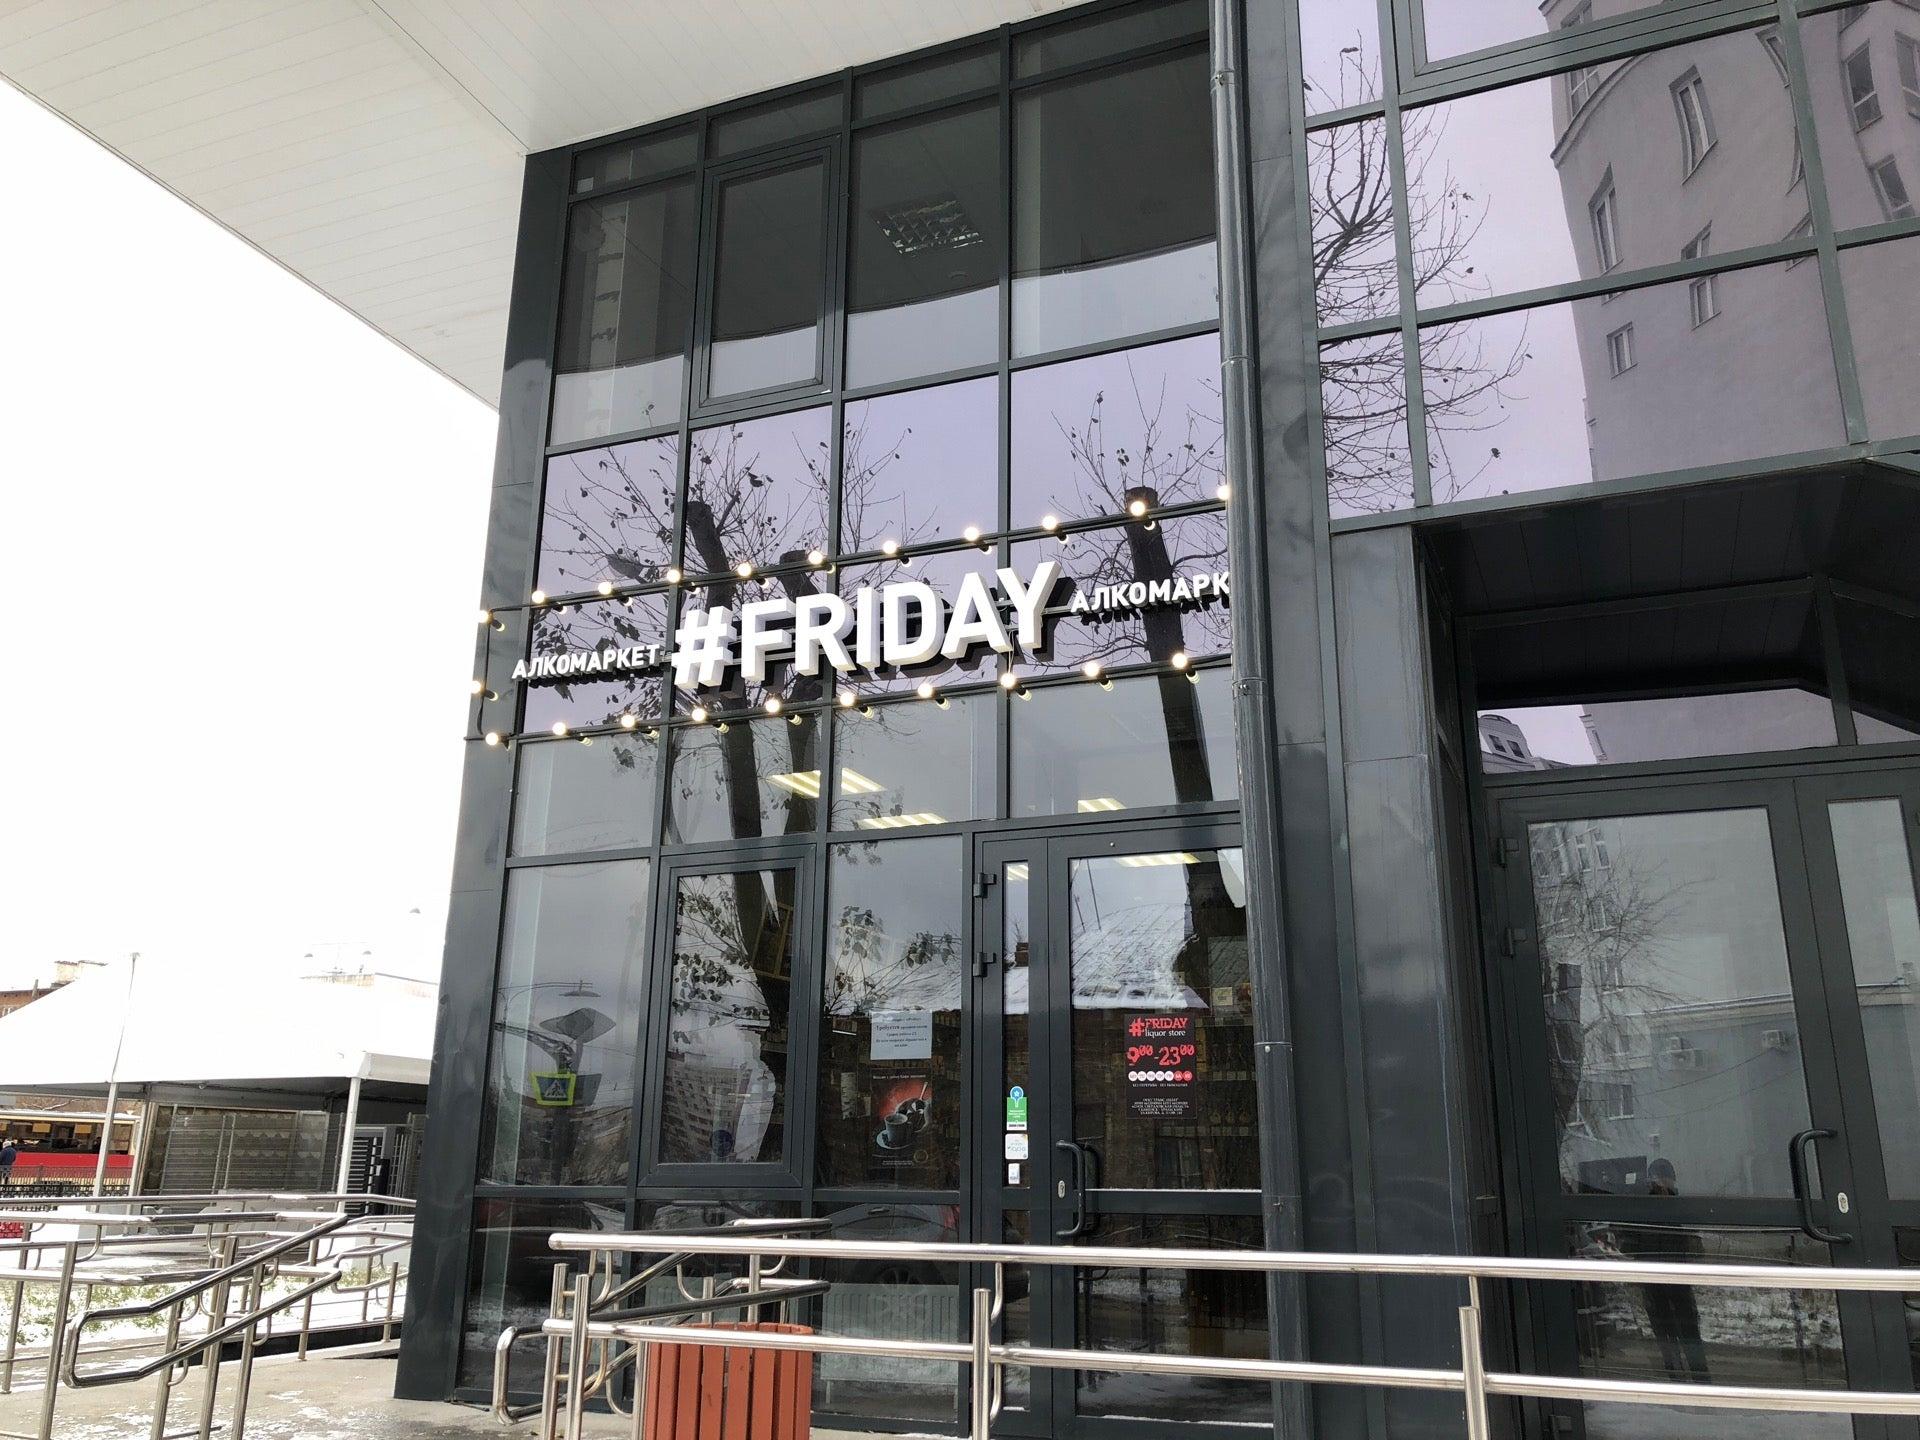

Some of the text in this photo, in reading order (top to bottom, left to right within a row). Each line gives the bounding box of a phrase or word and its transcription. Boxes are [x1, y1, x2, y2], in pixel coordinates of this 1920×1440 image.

[511, 644, 661, 679] АЛКОМАРКЕТ
[671, 561, 1061, 689] #FRIDAY
[1128, 1017, 1188, 1037] #FRIDAY
[1144, 1029, 1187, 1039] liquor store
